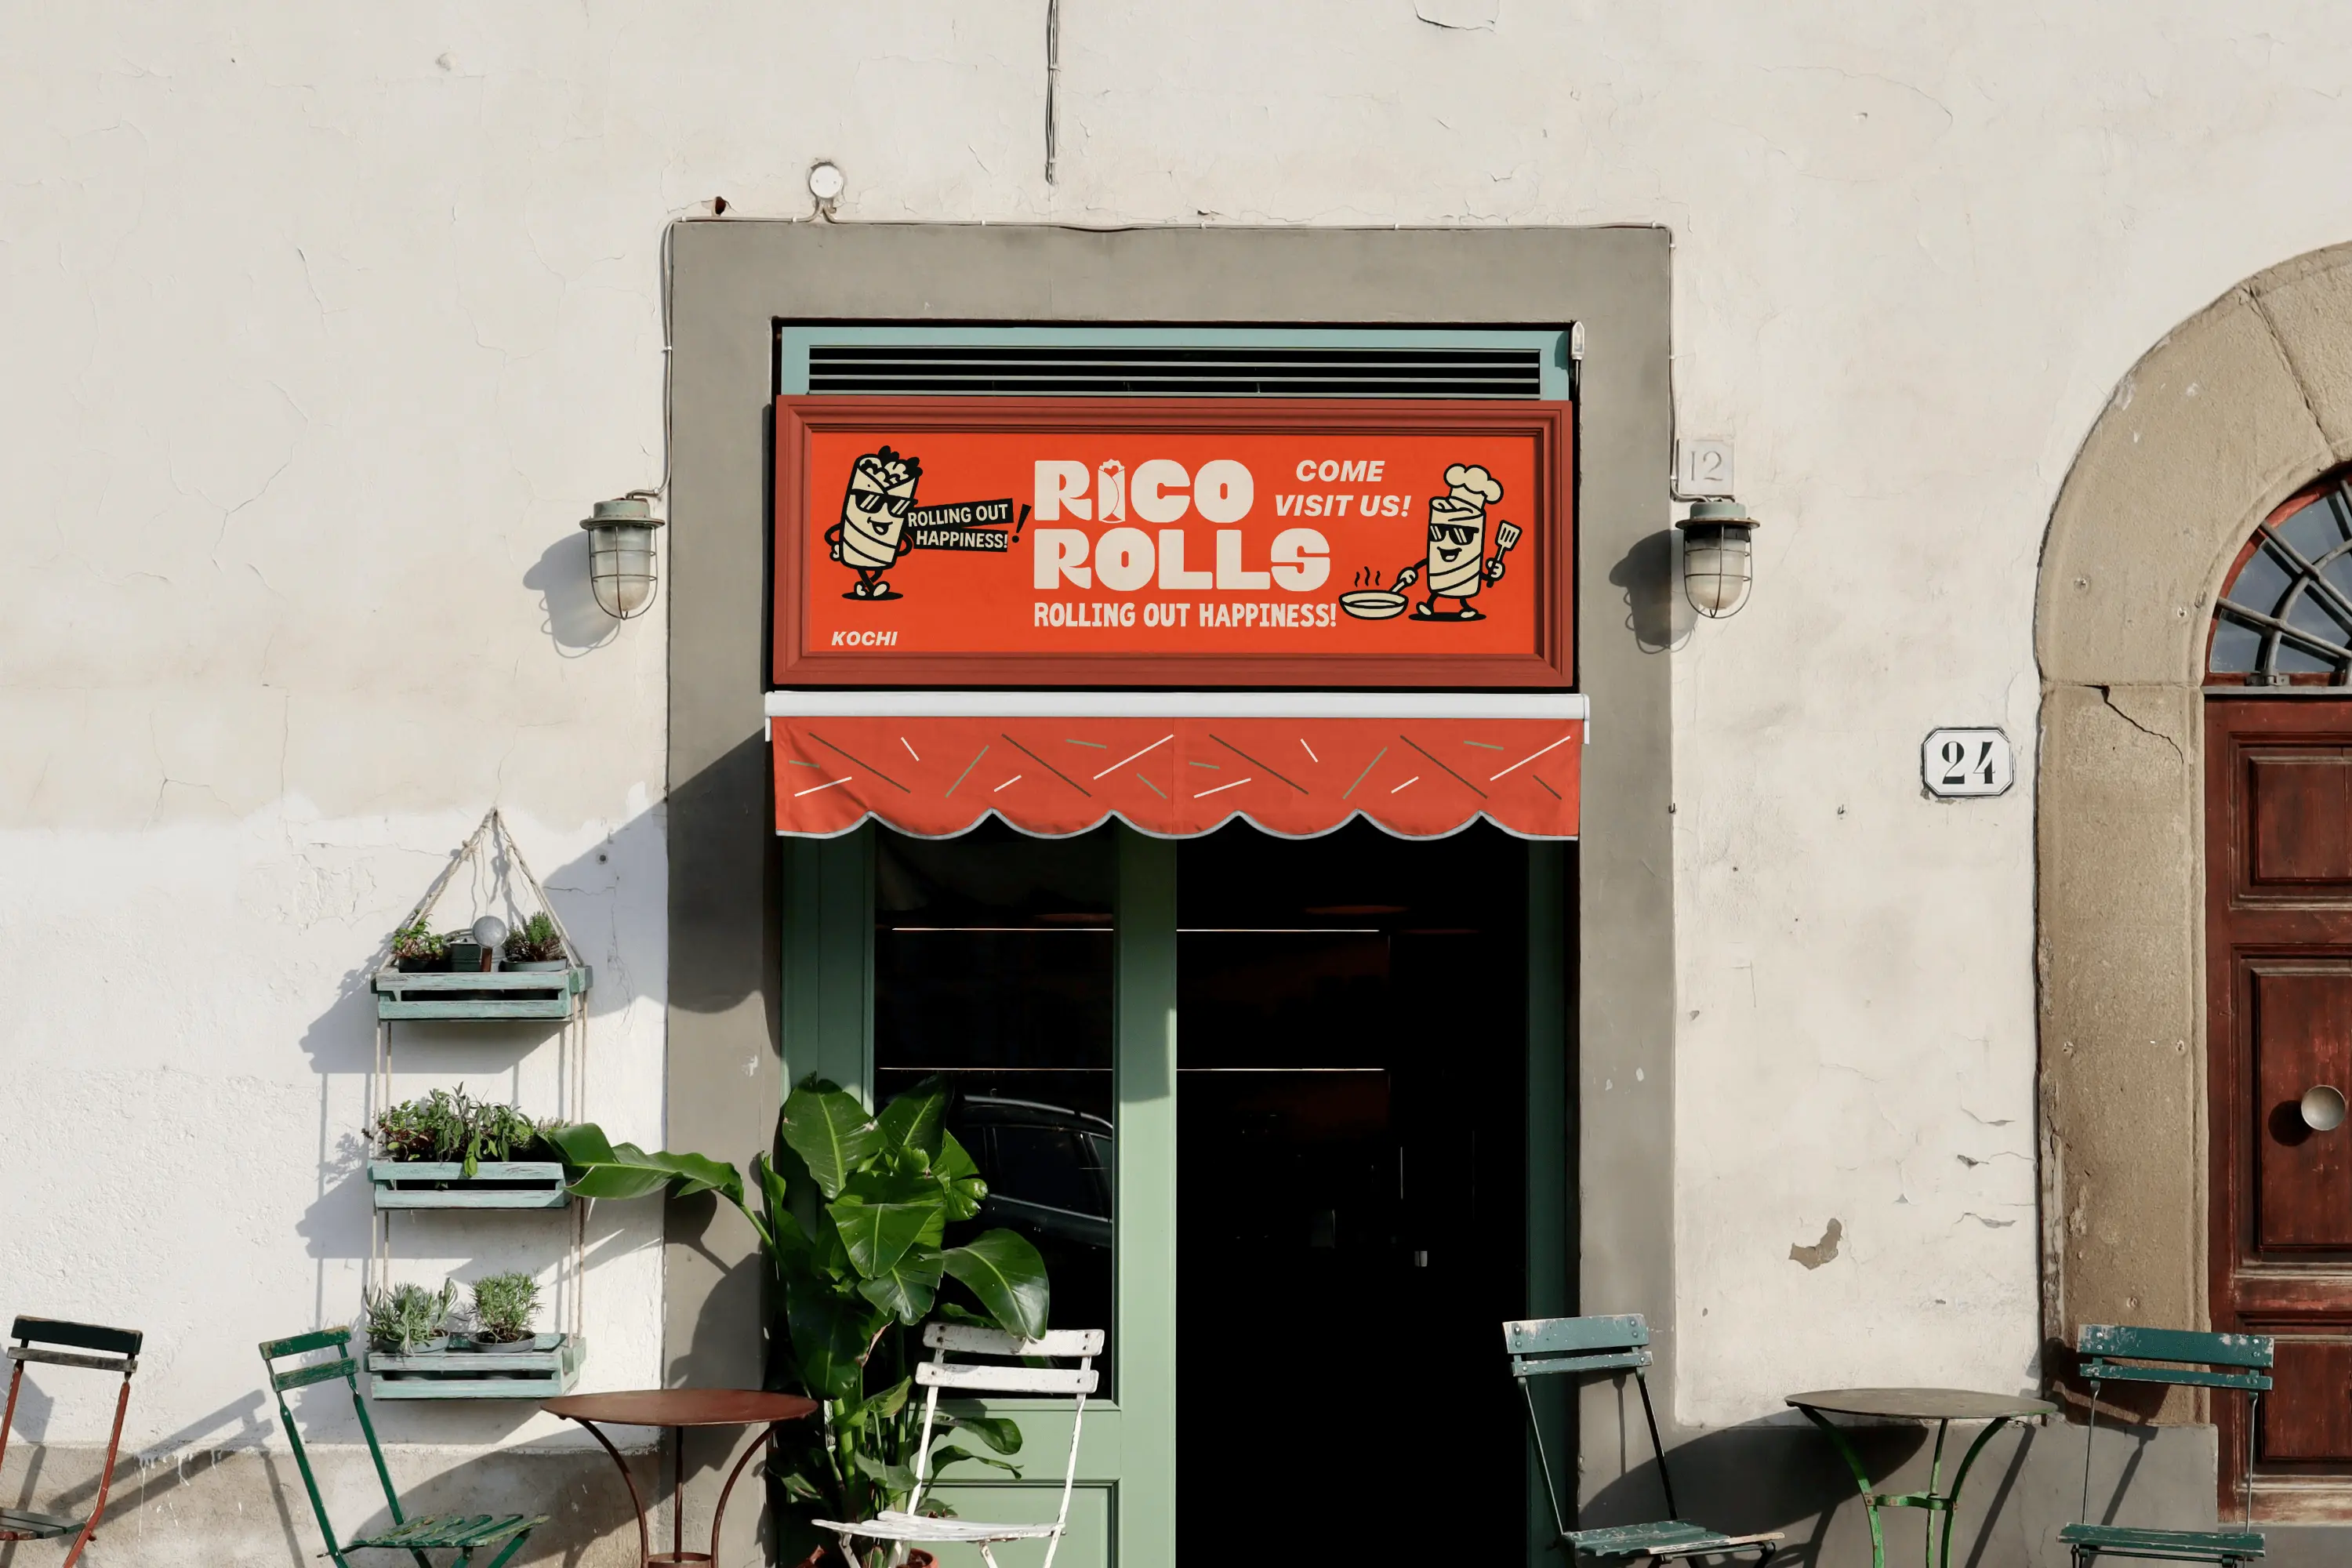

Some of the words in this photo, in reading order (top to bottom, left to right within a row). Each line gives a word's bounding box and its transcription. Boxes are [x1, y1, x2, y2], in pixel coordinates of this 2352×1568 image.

[1296, 459, 1385, 482] COME
[1690, 450, 1723, 481] 12
[907, 506, 971, 528] ROLLING
[975, 503, 1008, 521] OUT
[1275, 494, 1354, 517] VISIT
[1359, 495, 1412, 517] US!
[916, 530, 1008, 549] HAPPINESS!
[1033, 527, 1330, 592] ROLLS
[1034, 602, 1136, 627] ROLLING
[1143, 602, 1191, 627] OUT
[1199, 602, 1337, 628] HAPPINESS!
[831, 630, 898, 646] KOCHI
[1941, 741, 1996, 785] 24
